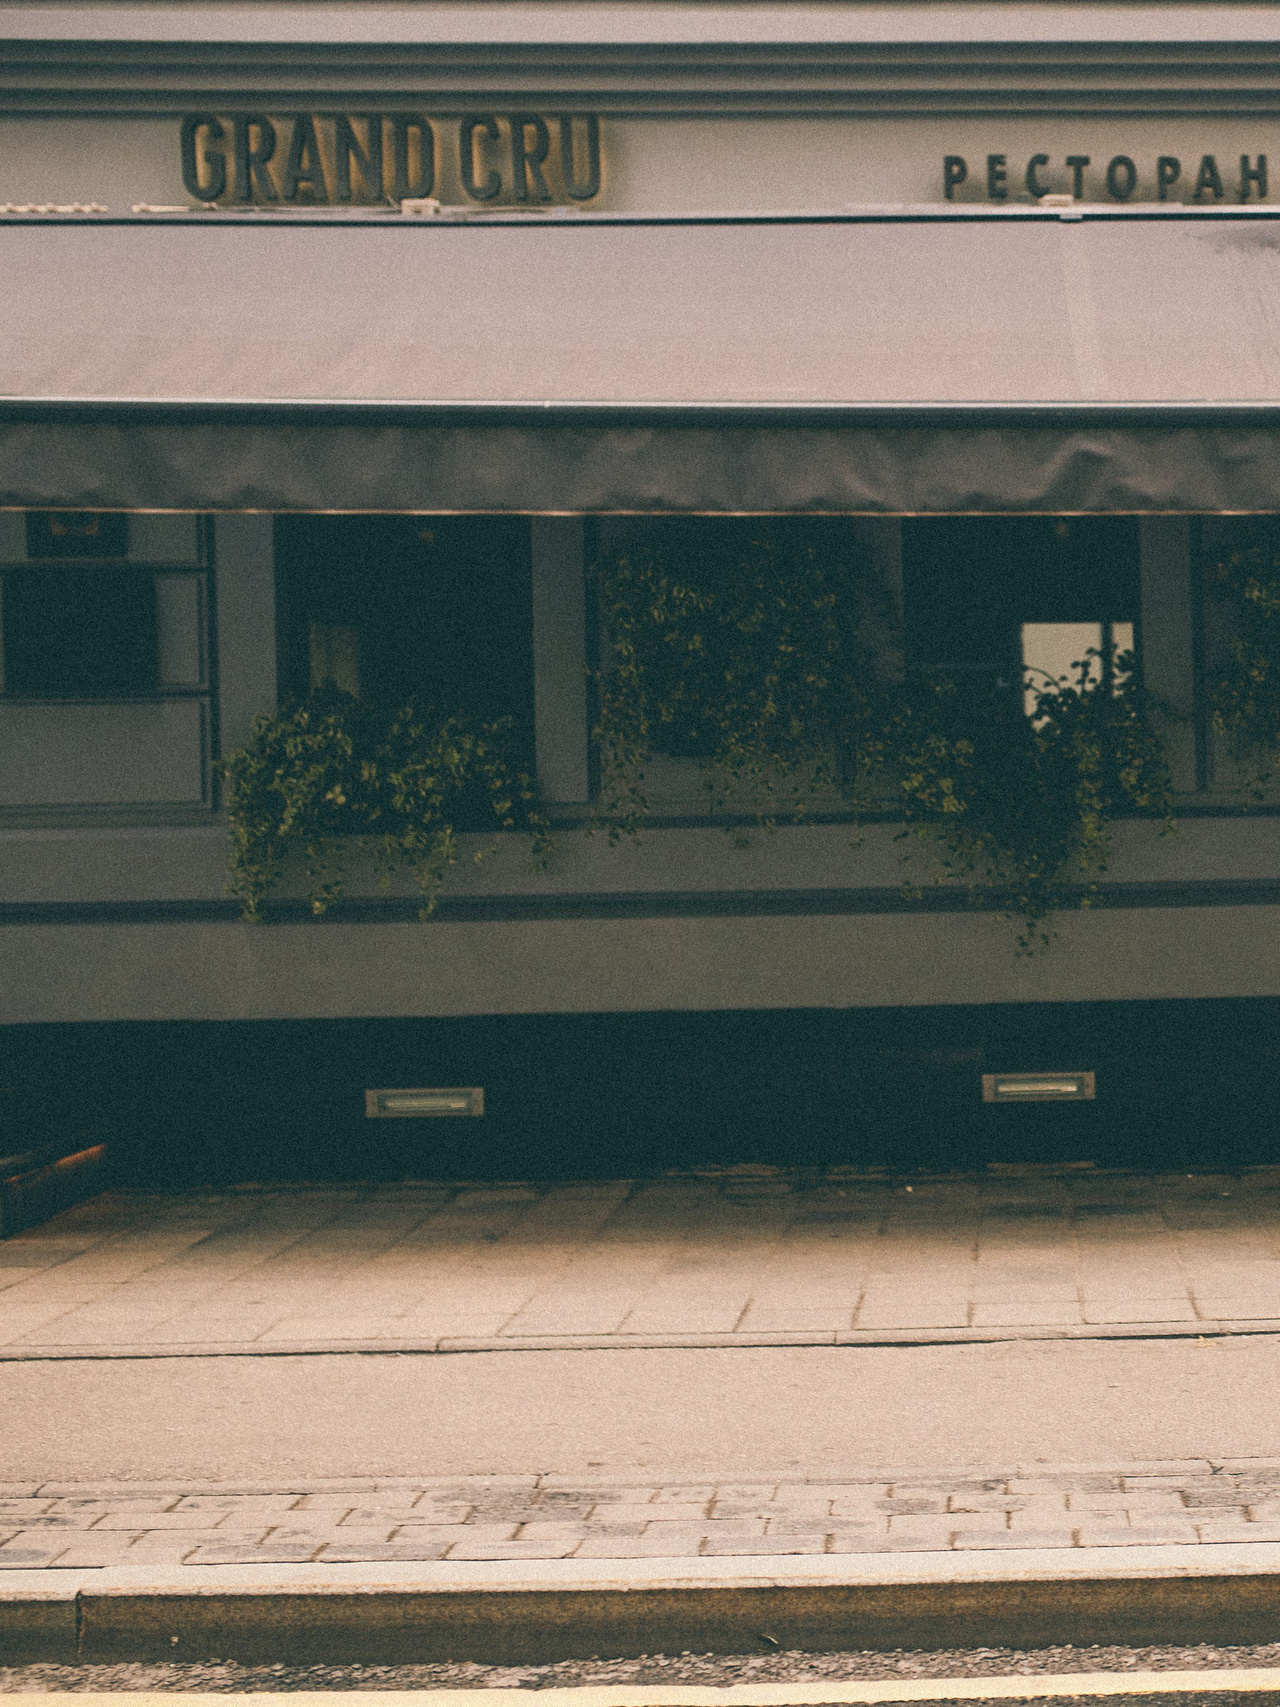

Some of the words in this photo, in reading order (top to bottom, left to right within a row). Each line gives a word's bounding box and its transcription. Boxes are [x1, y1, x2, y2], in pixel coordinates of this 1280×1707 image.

[180, 111, 435, 202] GRAND
[459, 111, 601, 202] CRU
[943, 153, 1269, 201] РЕСТОРАН
